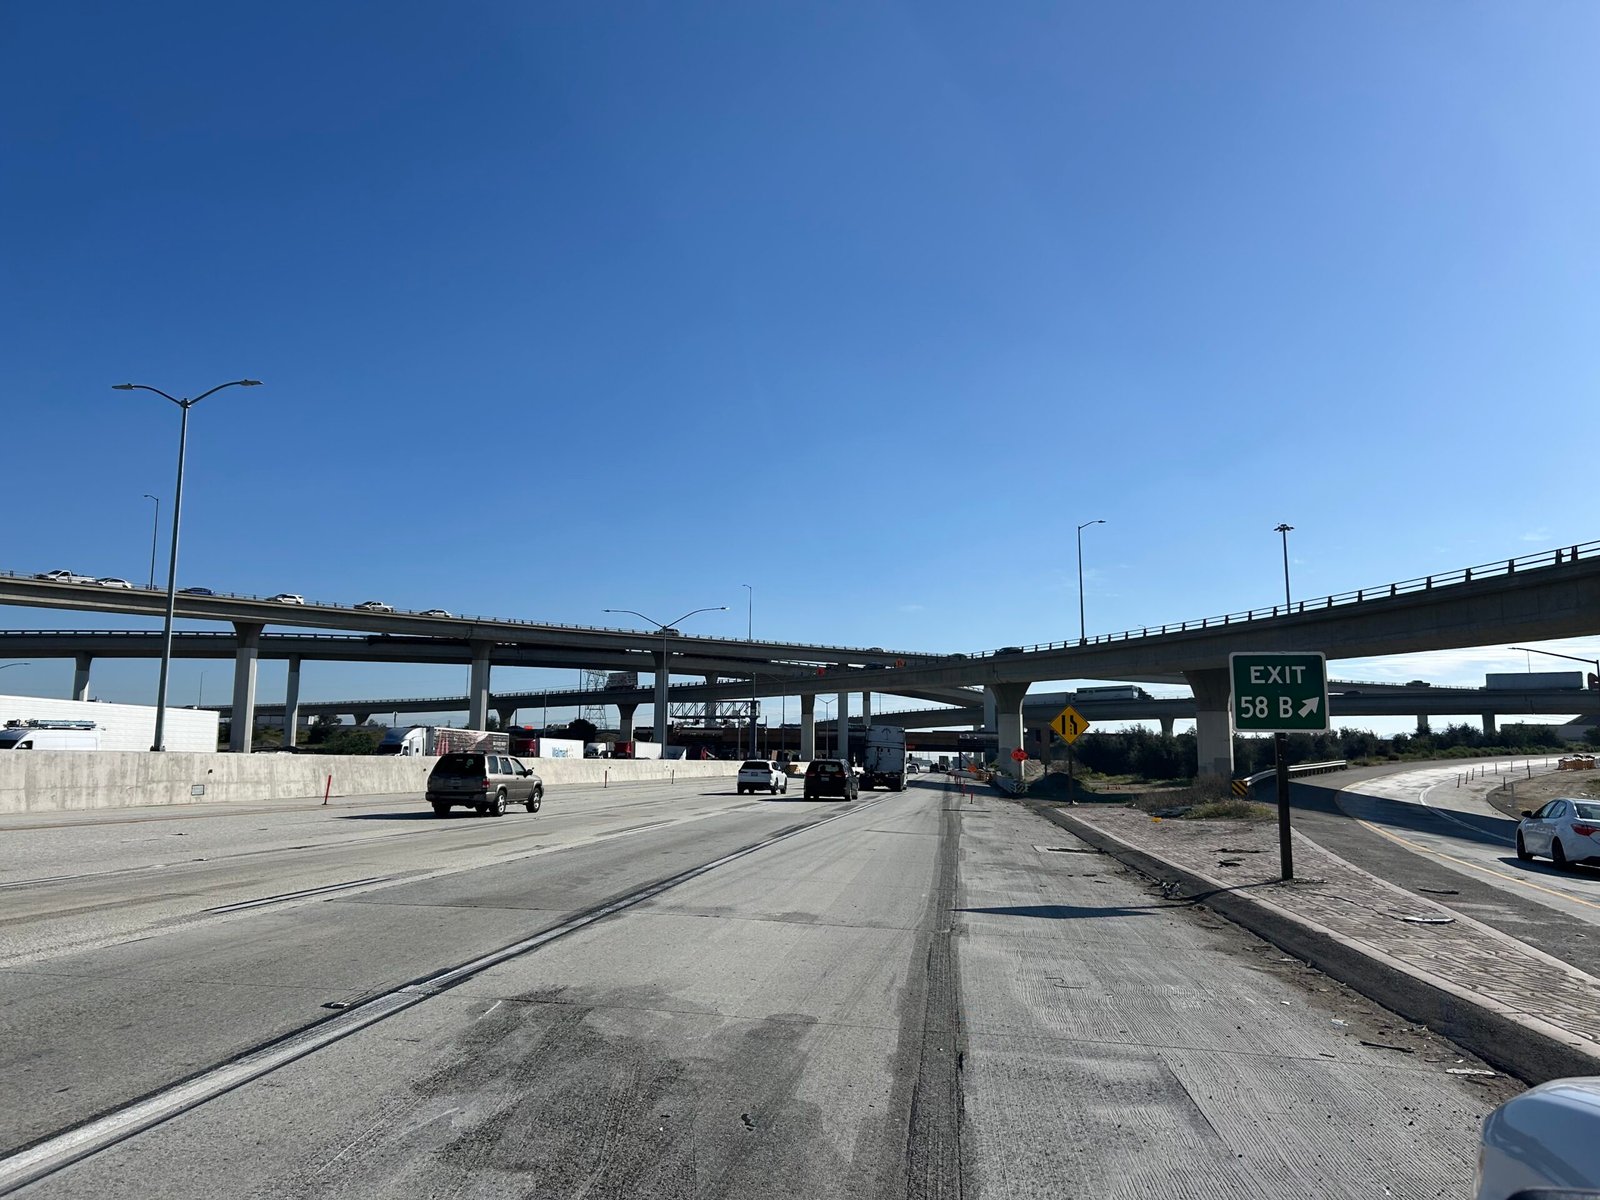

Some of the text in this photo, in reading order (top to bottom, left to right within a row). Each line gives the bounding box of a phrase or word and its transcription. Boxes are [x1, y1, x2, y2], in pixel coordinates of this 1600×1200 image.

[1250, 666, 1306, 684] EXIT
[1241, 696, 1293, 718] 58 B
